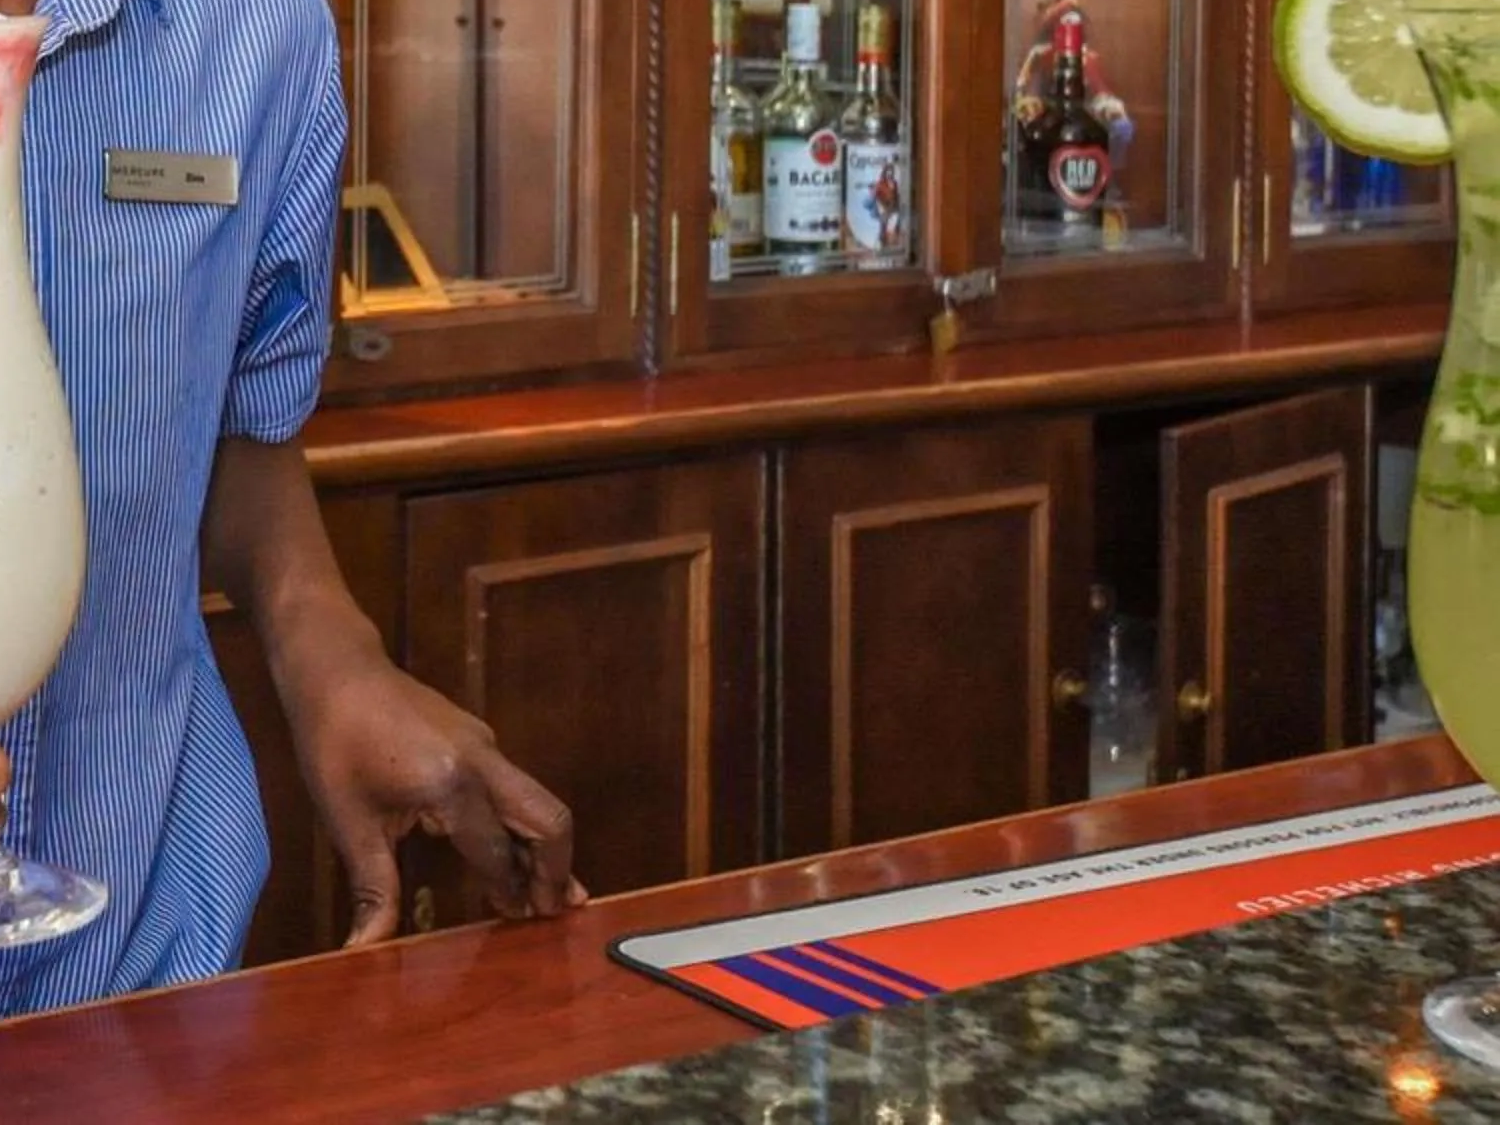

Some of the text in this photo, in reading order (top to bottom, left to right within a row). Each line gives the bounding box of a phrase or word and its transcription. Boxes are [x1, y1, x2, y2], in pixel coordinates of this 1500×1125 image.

[1085, 862, 1135, 877] THE
[1009, 879, 1038, 891] OF
[1039, 870, 1084, 885] AGE
[1236, 869, 1429, 914] RICHELIEU
